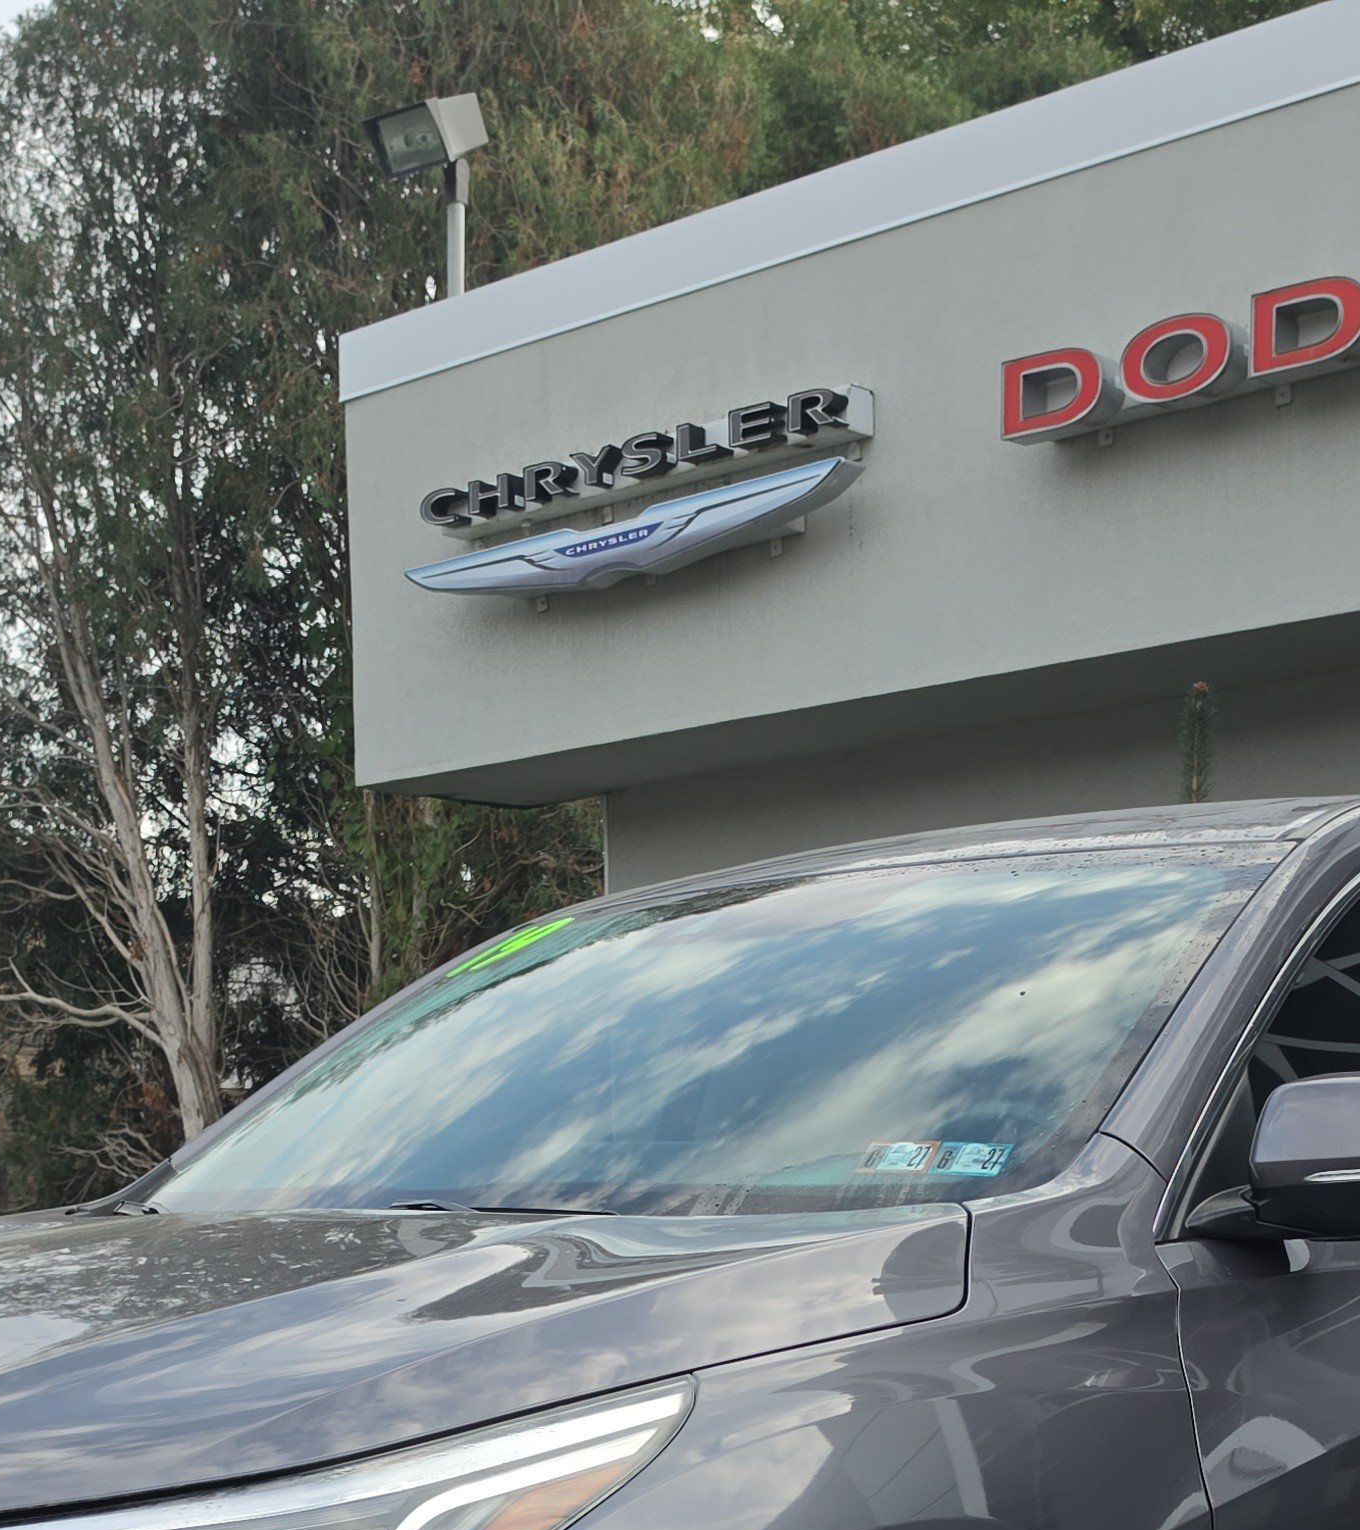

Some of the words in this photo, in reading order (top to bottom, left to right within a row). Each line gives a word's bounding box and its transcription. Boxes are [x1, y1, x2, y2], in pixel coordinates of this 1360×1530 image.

[420, 388, 848, 527] CHRYSLER
[565, 529, 649, 556] CHRYSLER
[907, 1146, 931, 1170] 27
[981, 1148, 1006, 1170] 27
